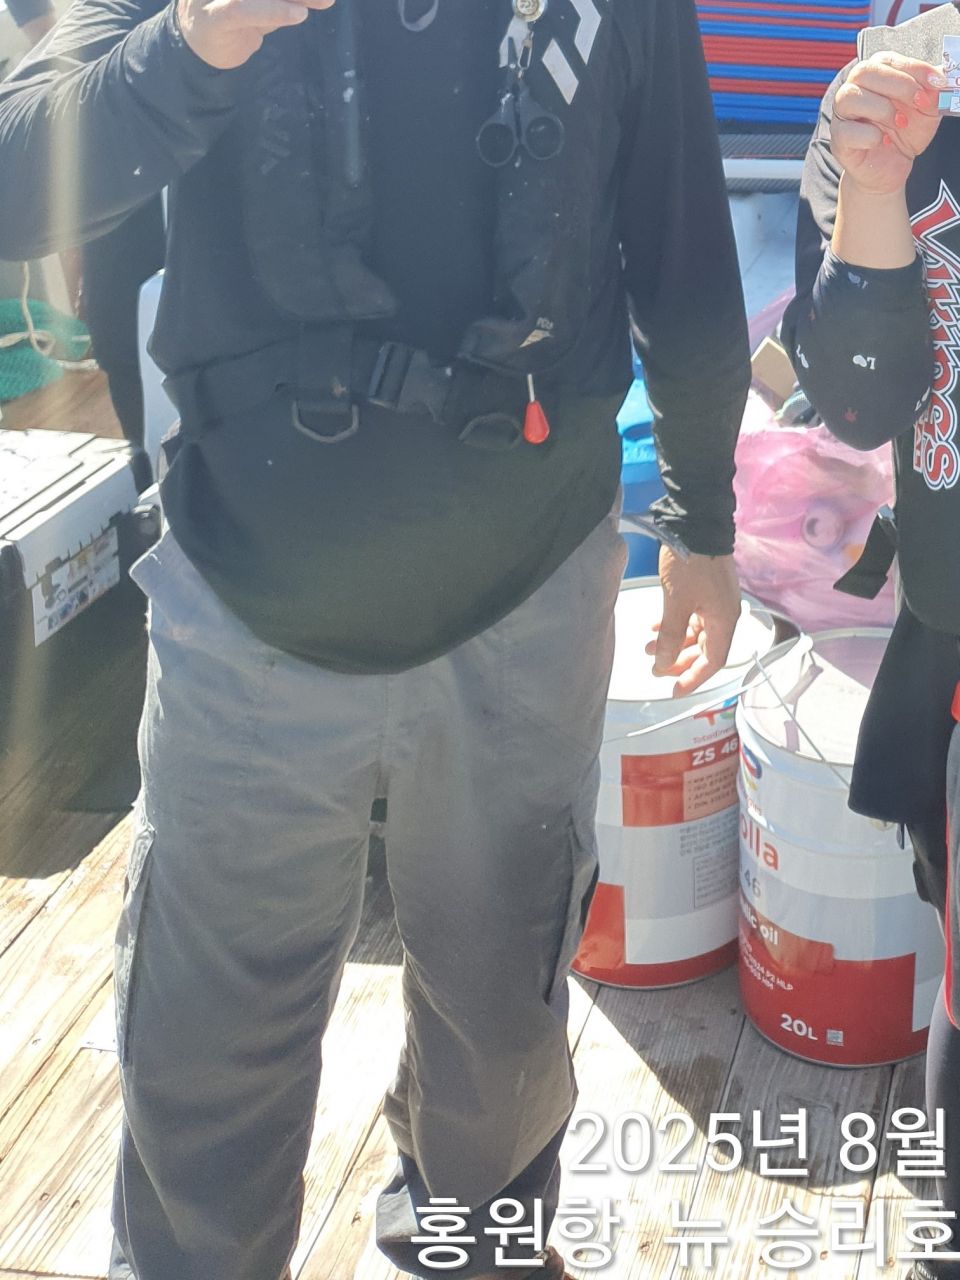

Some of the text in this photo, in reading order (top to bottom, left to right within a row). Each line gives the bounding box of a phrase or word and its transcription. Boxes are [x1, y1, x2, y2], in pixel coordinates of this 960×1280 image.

[692, 748, 715, 766] ZS
[760, 924, 779, 945] oil
[780, 1013, 818, 1041] 20L
